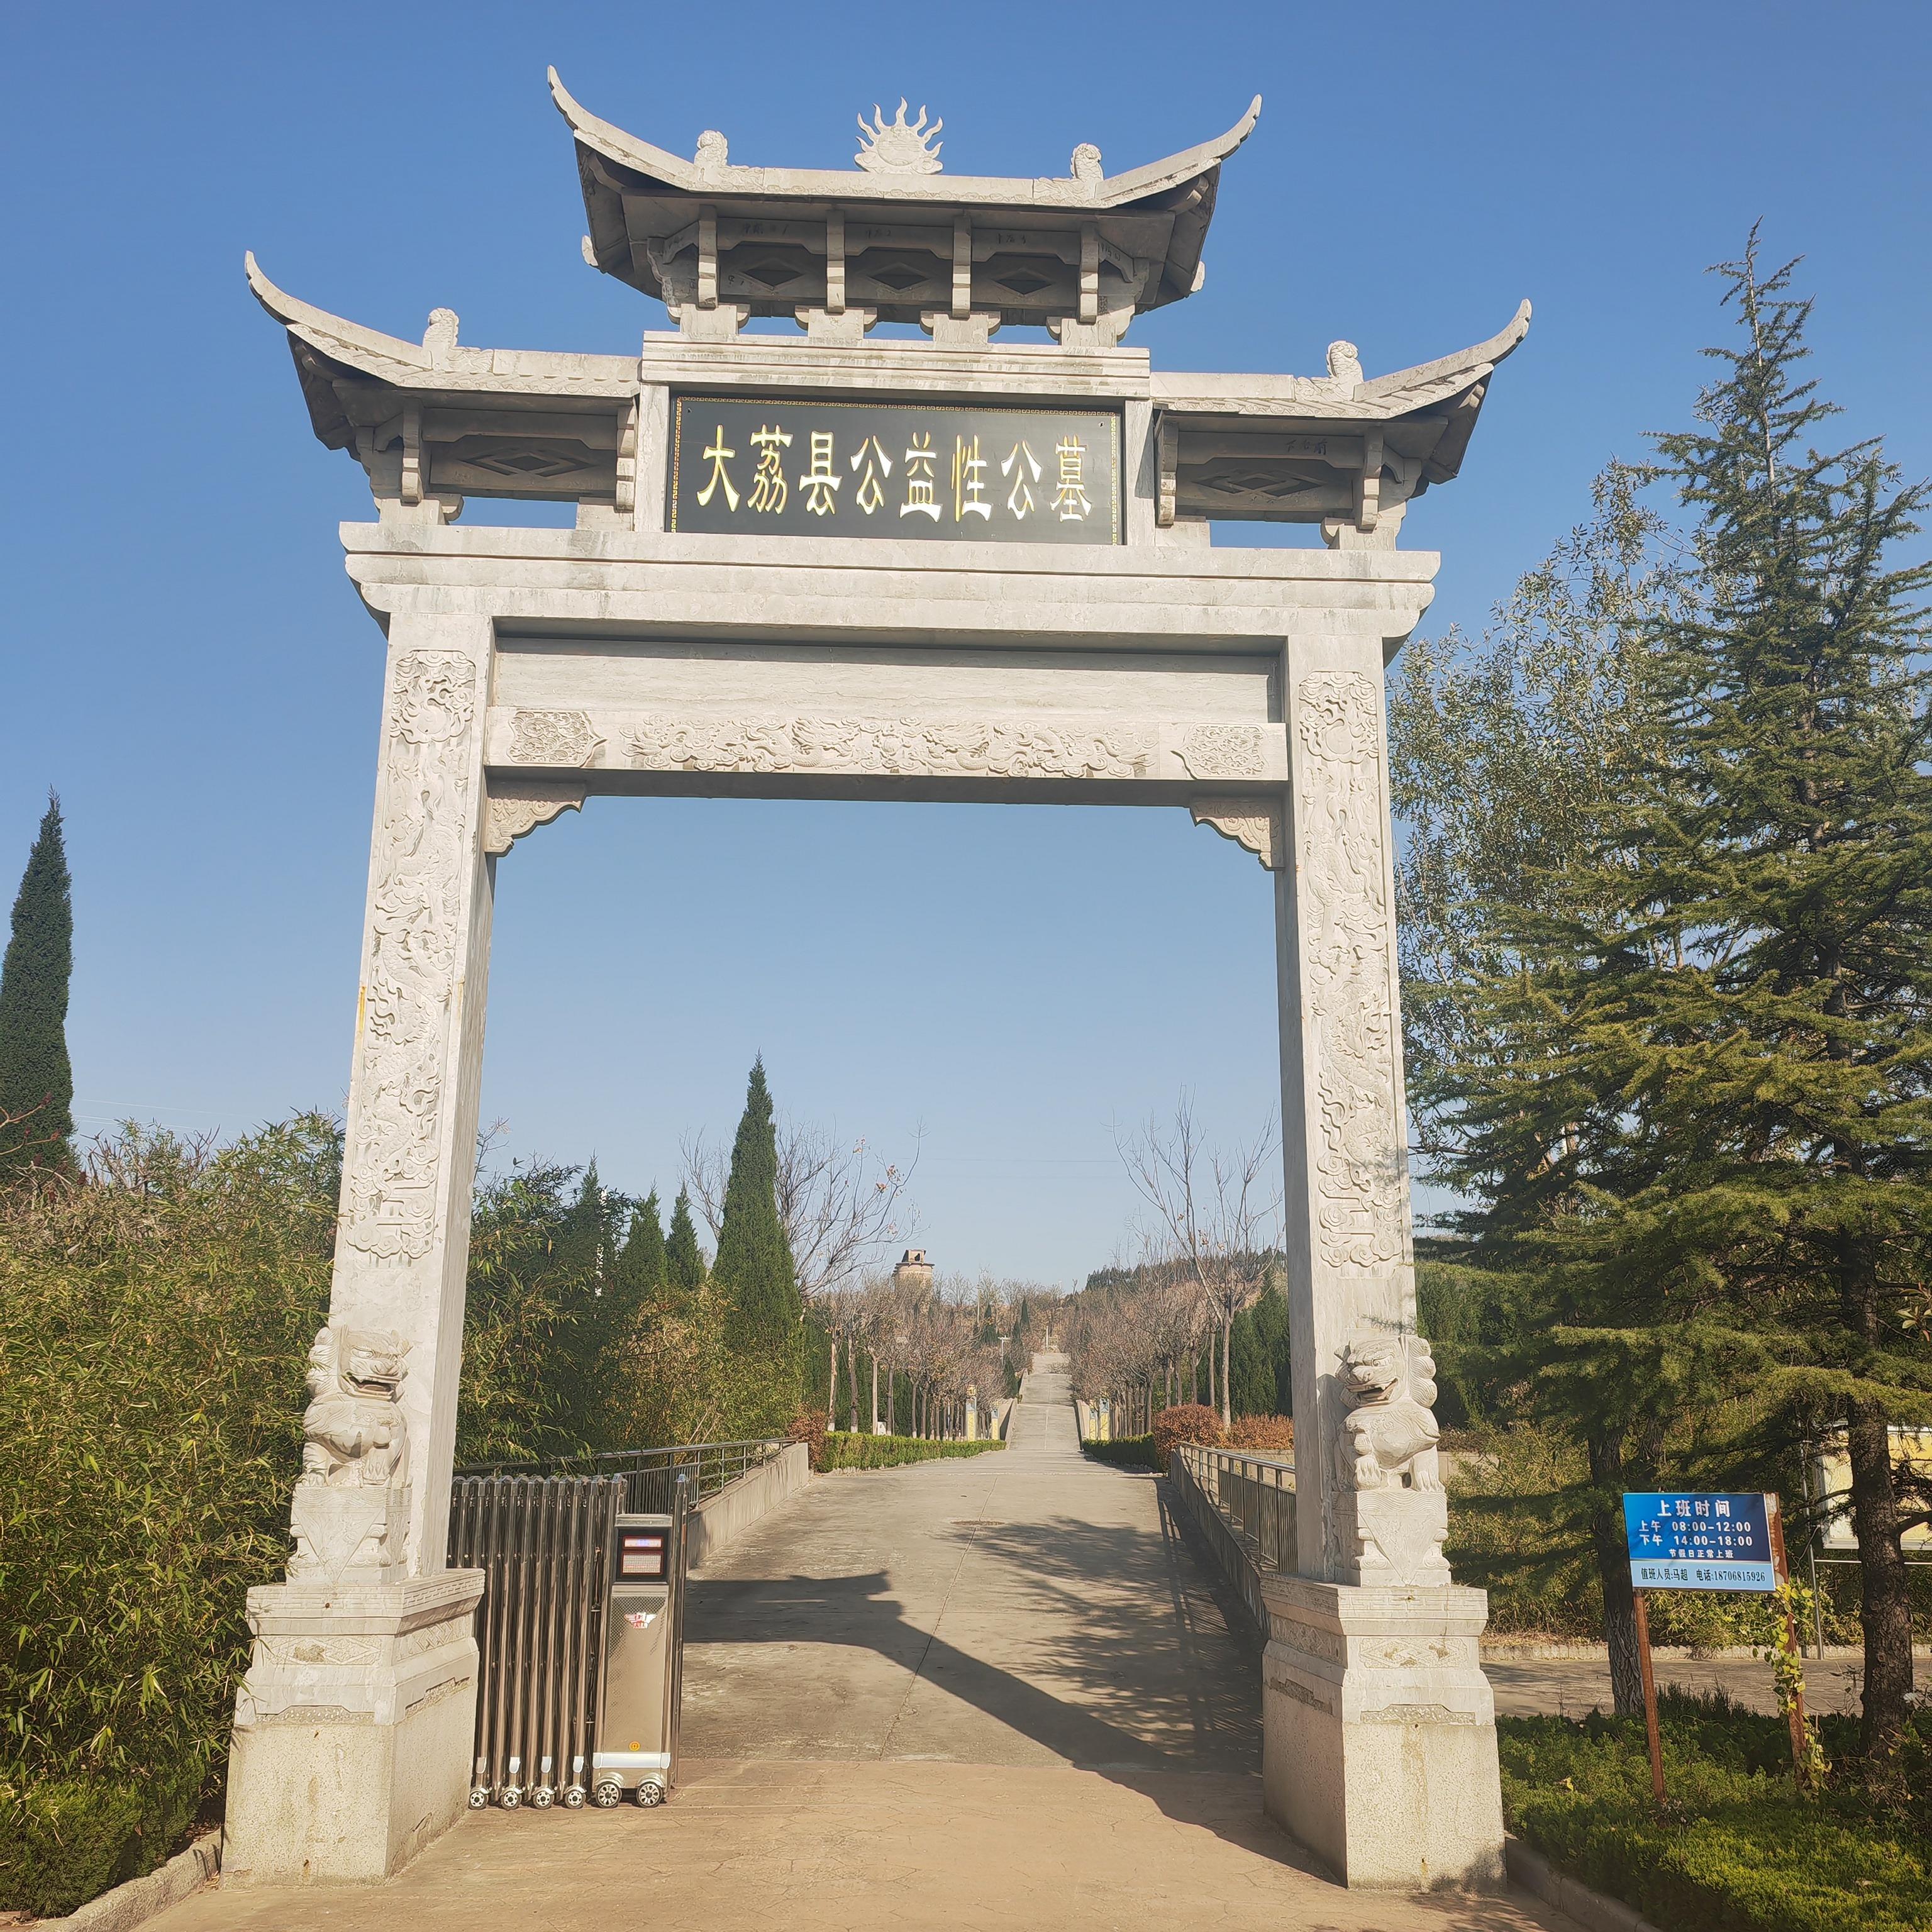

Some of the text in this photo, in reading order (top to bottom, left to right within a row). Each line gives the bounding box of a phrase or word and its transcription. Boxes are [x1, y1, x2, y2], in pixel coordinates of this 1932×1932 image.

[696, 423, 1093, 523] 大荔县公益性公墓
[1657, 1499, 1731, 1518] 上班时间
[1638, 1519, 1751, 1533] 上午 08:00-12:00
[1639, 1534, 1753, 1546] 下午 14:00-18:00
[1668, 1548, 1734, 1558] 节假日正常上班
[1641, 1567, 1689, 1581] 值班人员:马超
